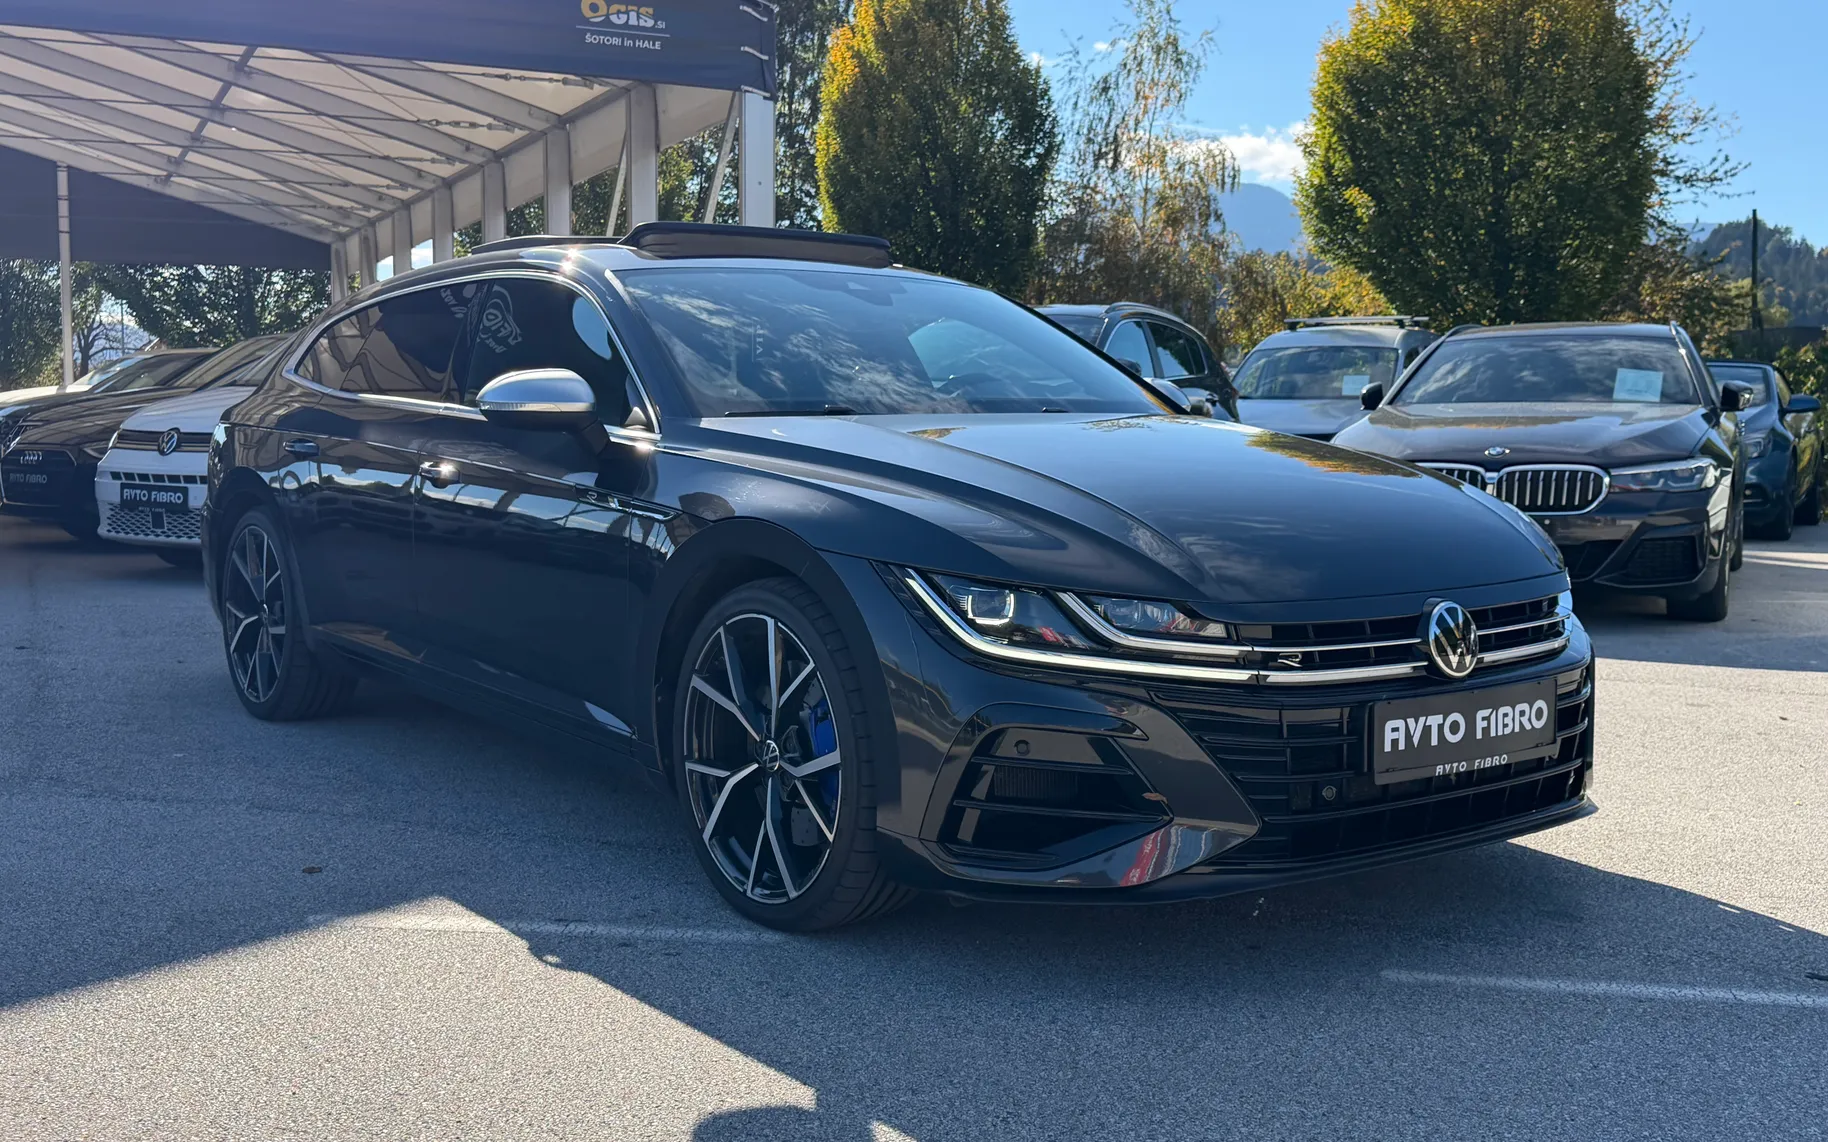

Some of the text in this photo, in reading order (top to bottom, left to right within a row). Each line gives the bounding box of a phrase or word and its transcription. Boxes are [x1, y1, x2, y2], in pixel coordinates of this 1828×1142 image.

[585, 32, 662, 50] ŠOTORI in HALE
[123, 488, 184, 504] AVTO FIBRO
[1384, 699, 1549, 752] AVTO FIBRO
[1435, 754, 1508, 776] AVTO FIBRO
